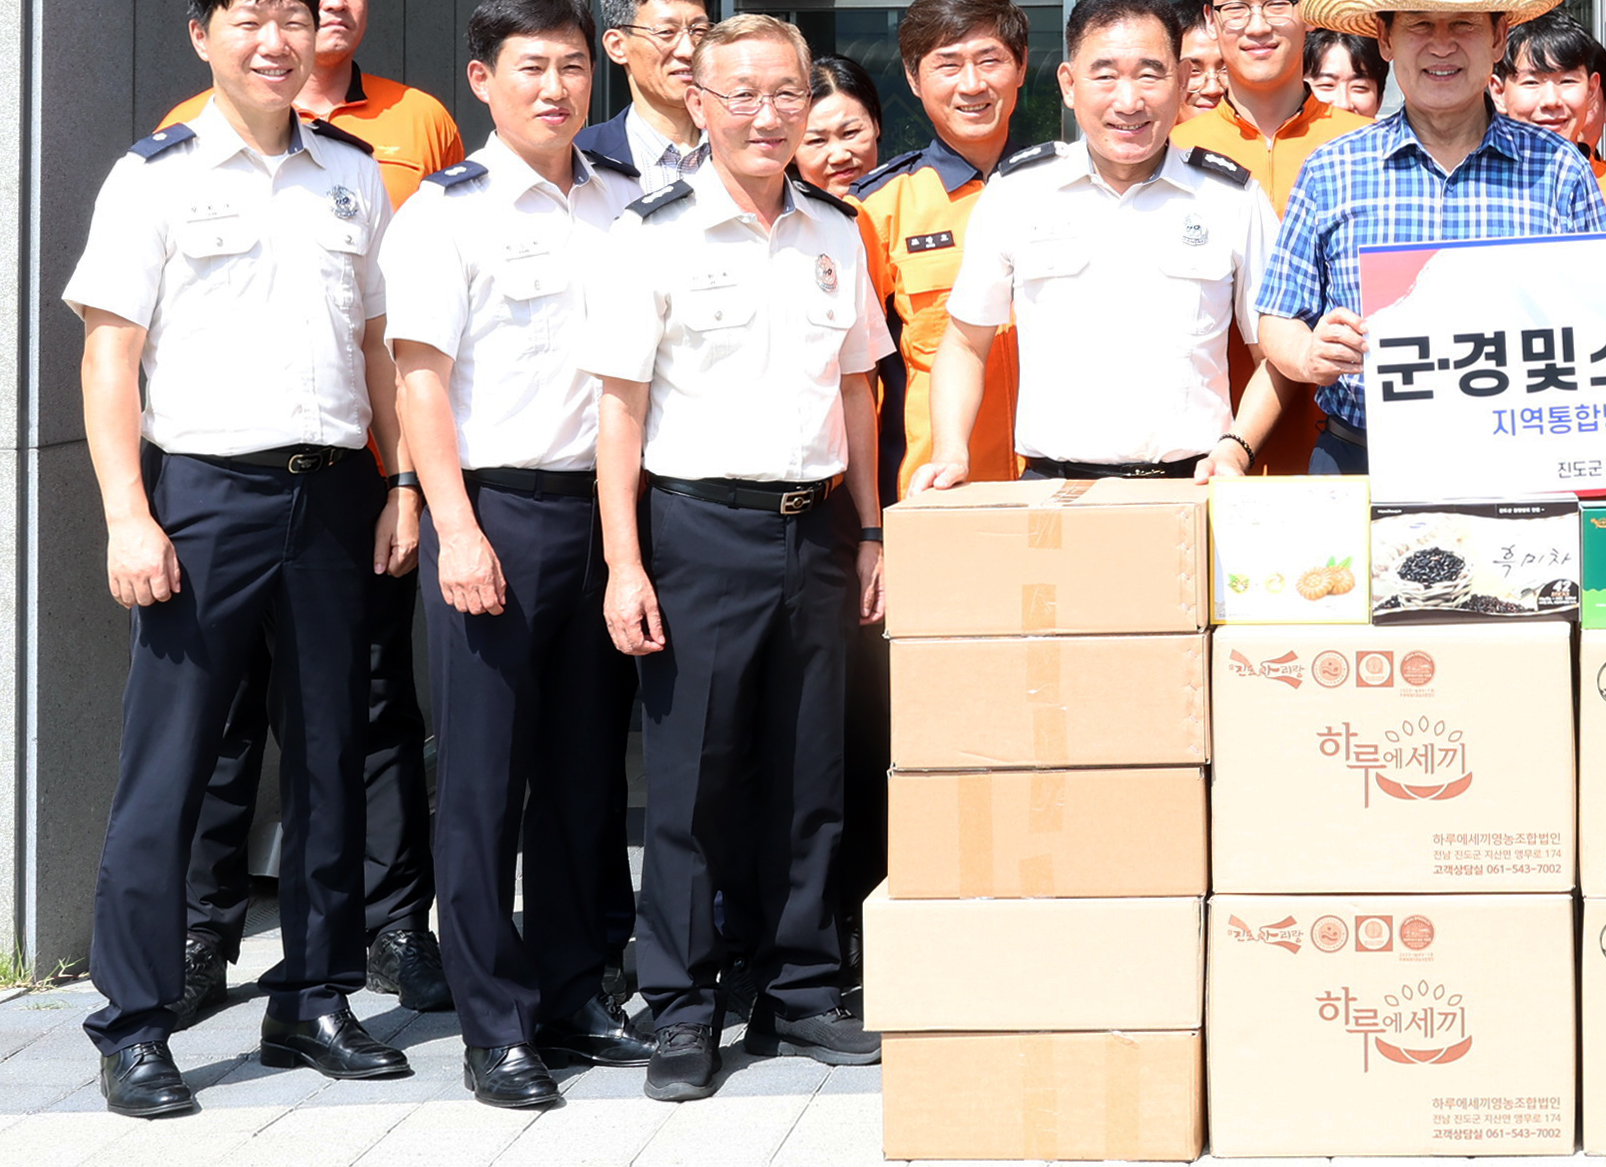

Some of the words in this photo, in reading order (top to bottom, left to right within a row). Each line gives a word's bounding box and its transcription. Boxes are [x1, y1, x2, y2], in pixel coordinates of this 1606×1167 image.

[1377, 328, 1510, 401] 군·경
[1521, 325, 1578, 393] 및
[1557, 458, 1603, 479] 진도군
[1493, 544, 1571, 578] 흑미차
[1552, 580, 1571, 592] 42
[1316, 722, 1466, 809] 하루에세끼
[1433, 832, 1561, 846] 하루에세끼영농조합법인
[1454, 849, 1481, 860] 진도군
[1545, 849, 1562, 860] 174
[1433, 864, 1483, 876] 고객상담실
[1487, 864, 1562, 874] 061-543-7002
[1315, 987, 1466, 1073] 하루에세끼
[1432, 1097, 1561, 1110] 하루에세끼영농조합법인
[1454, 1114, 1481, 1125] 진도군
[1545, 1114, 1561, 1125] 174
[1432, 1128, 1483, 1140] 고객상담실
[1486, 1128, 1561, 1138] 061-543-7002
